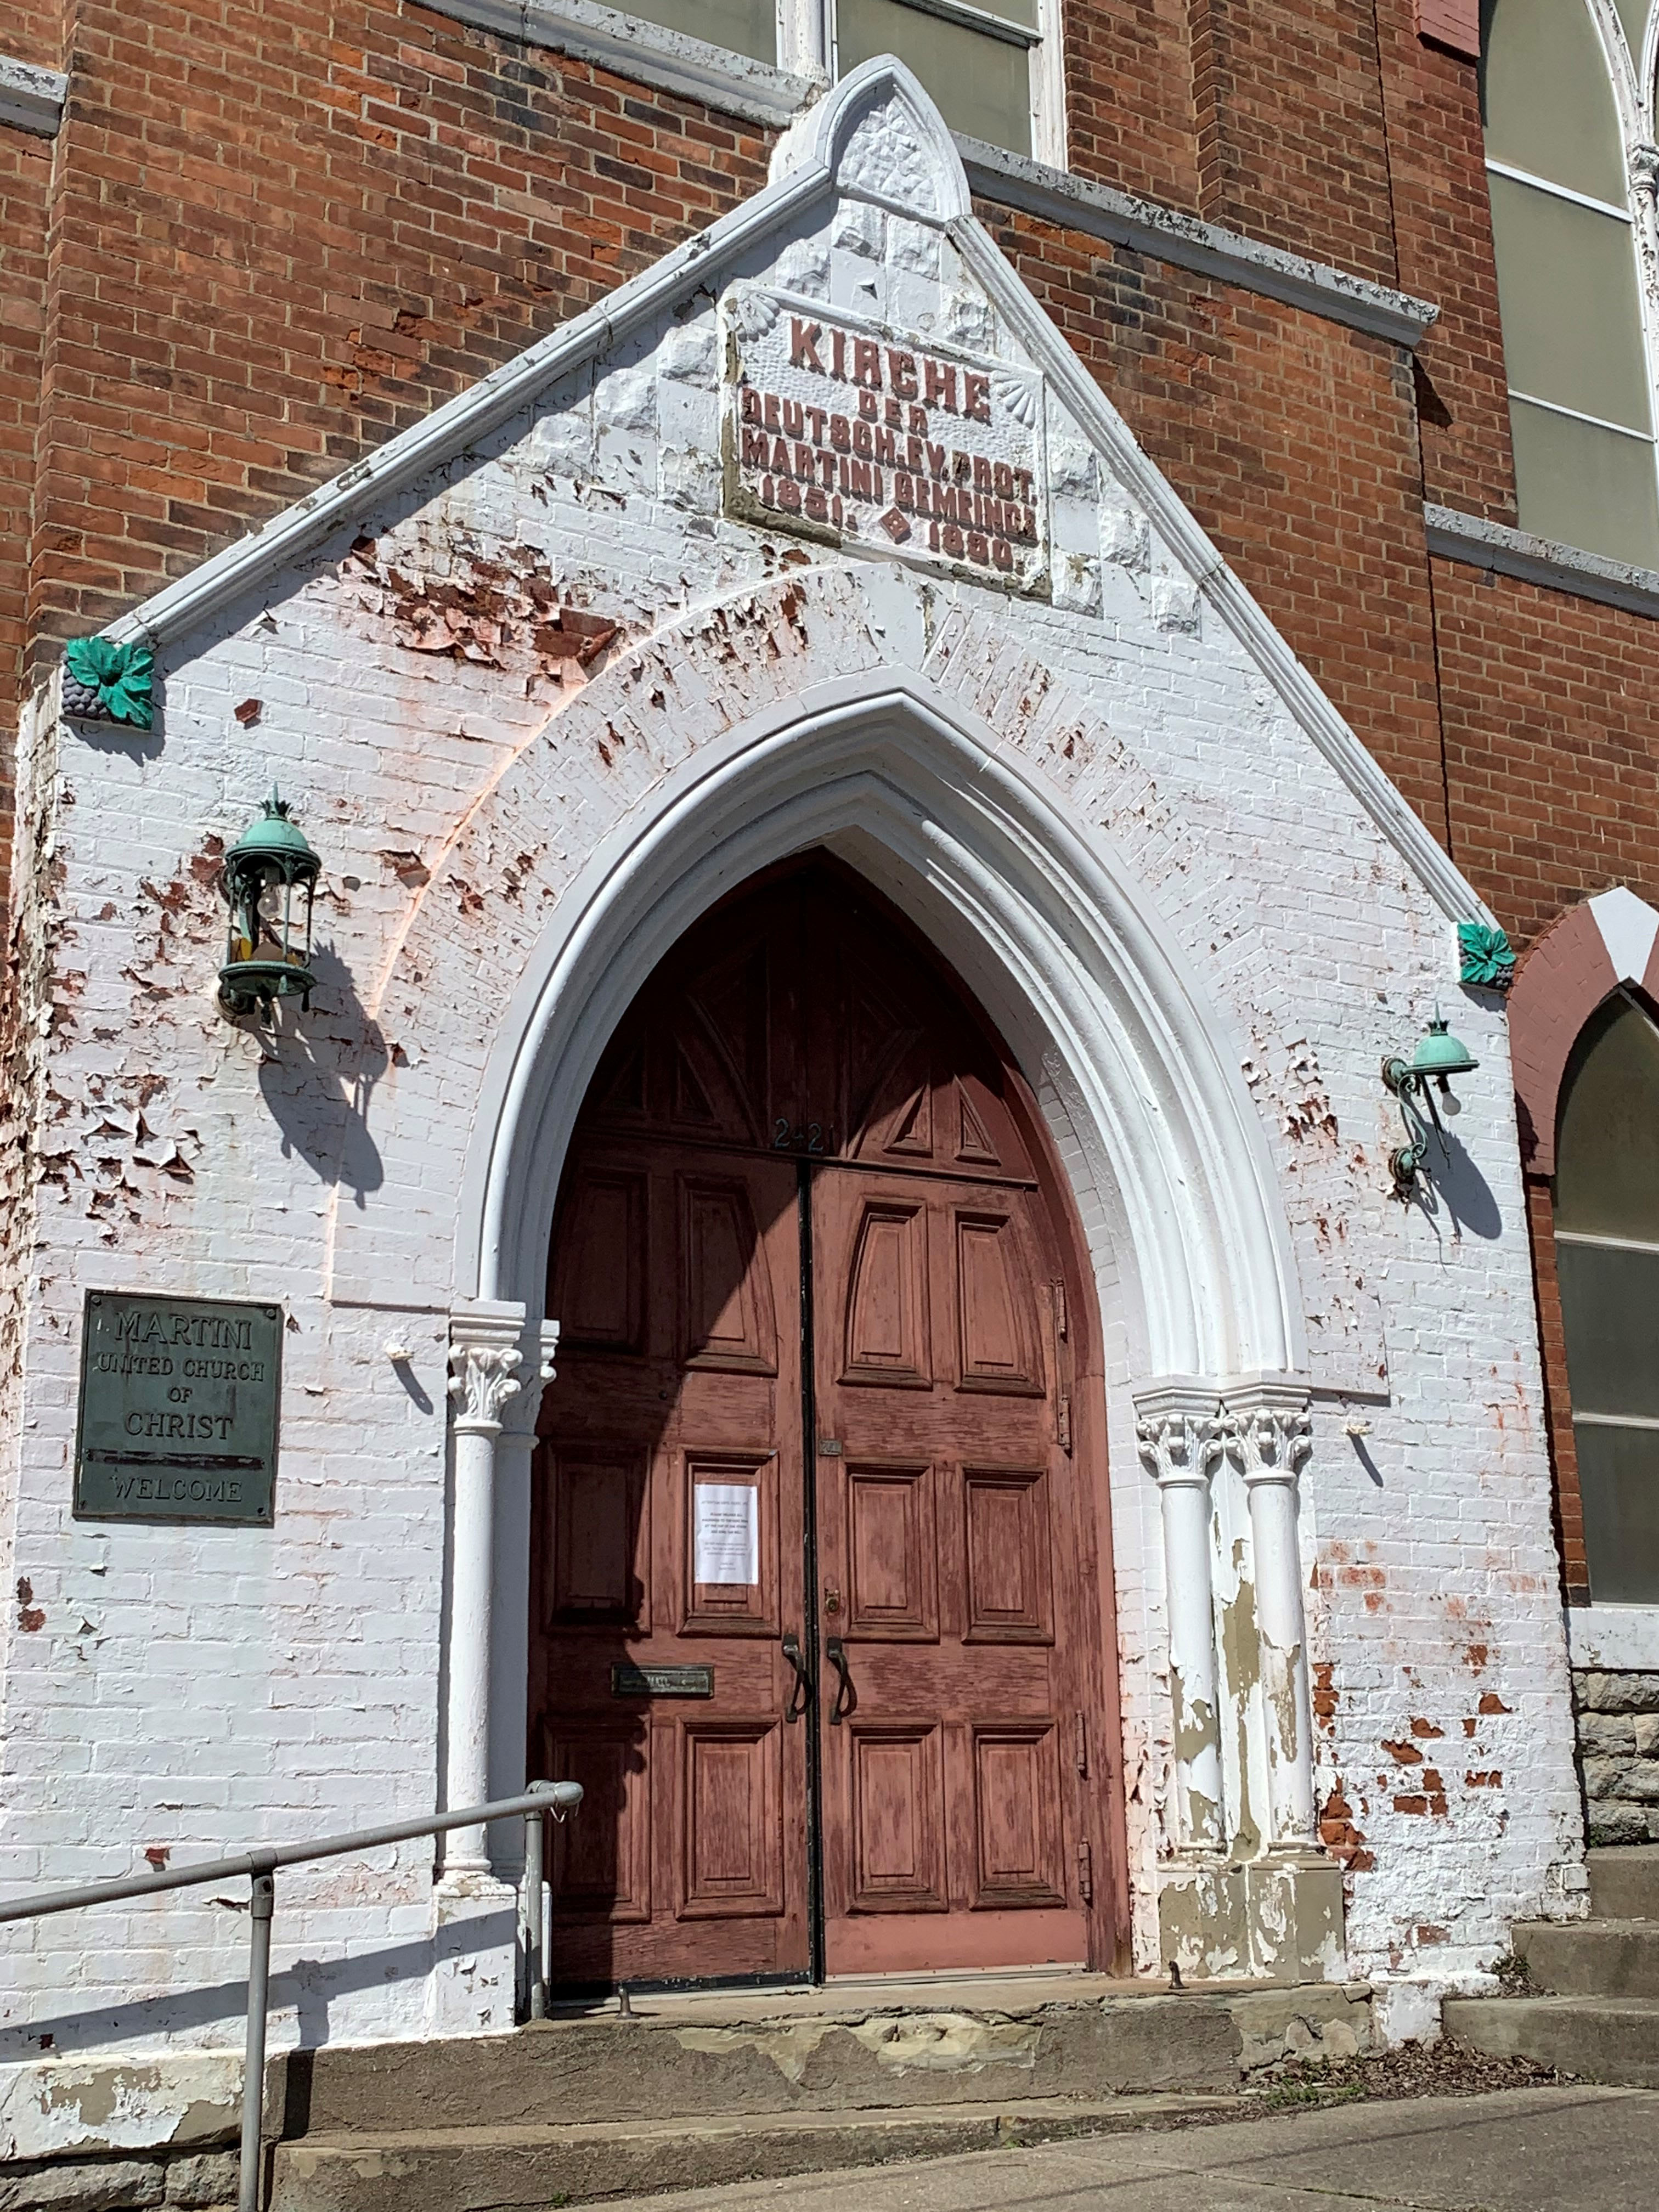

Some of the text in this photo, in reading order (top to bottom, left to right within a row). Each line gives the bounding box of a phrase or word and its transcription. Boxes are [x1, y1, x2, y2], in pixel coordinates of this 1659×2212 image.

[789, 316, 991, 426] KIRCHE
[859, 390, 928, 438] DER
[742, 427, 1037, 546] MARTINI GEMEINDE
[115, 1312, 252, 1350] MARTINI
[97, 1352, 264, 1381] UNITED CHURCH
[167, 1386, 193, 1403] OF
[126, 1412, 233, 1440] CHRIST
[111, 1475, 242, 1502] WELCOME
